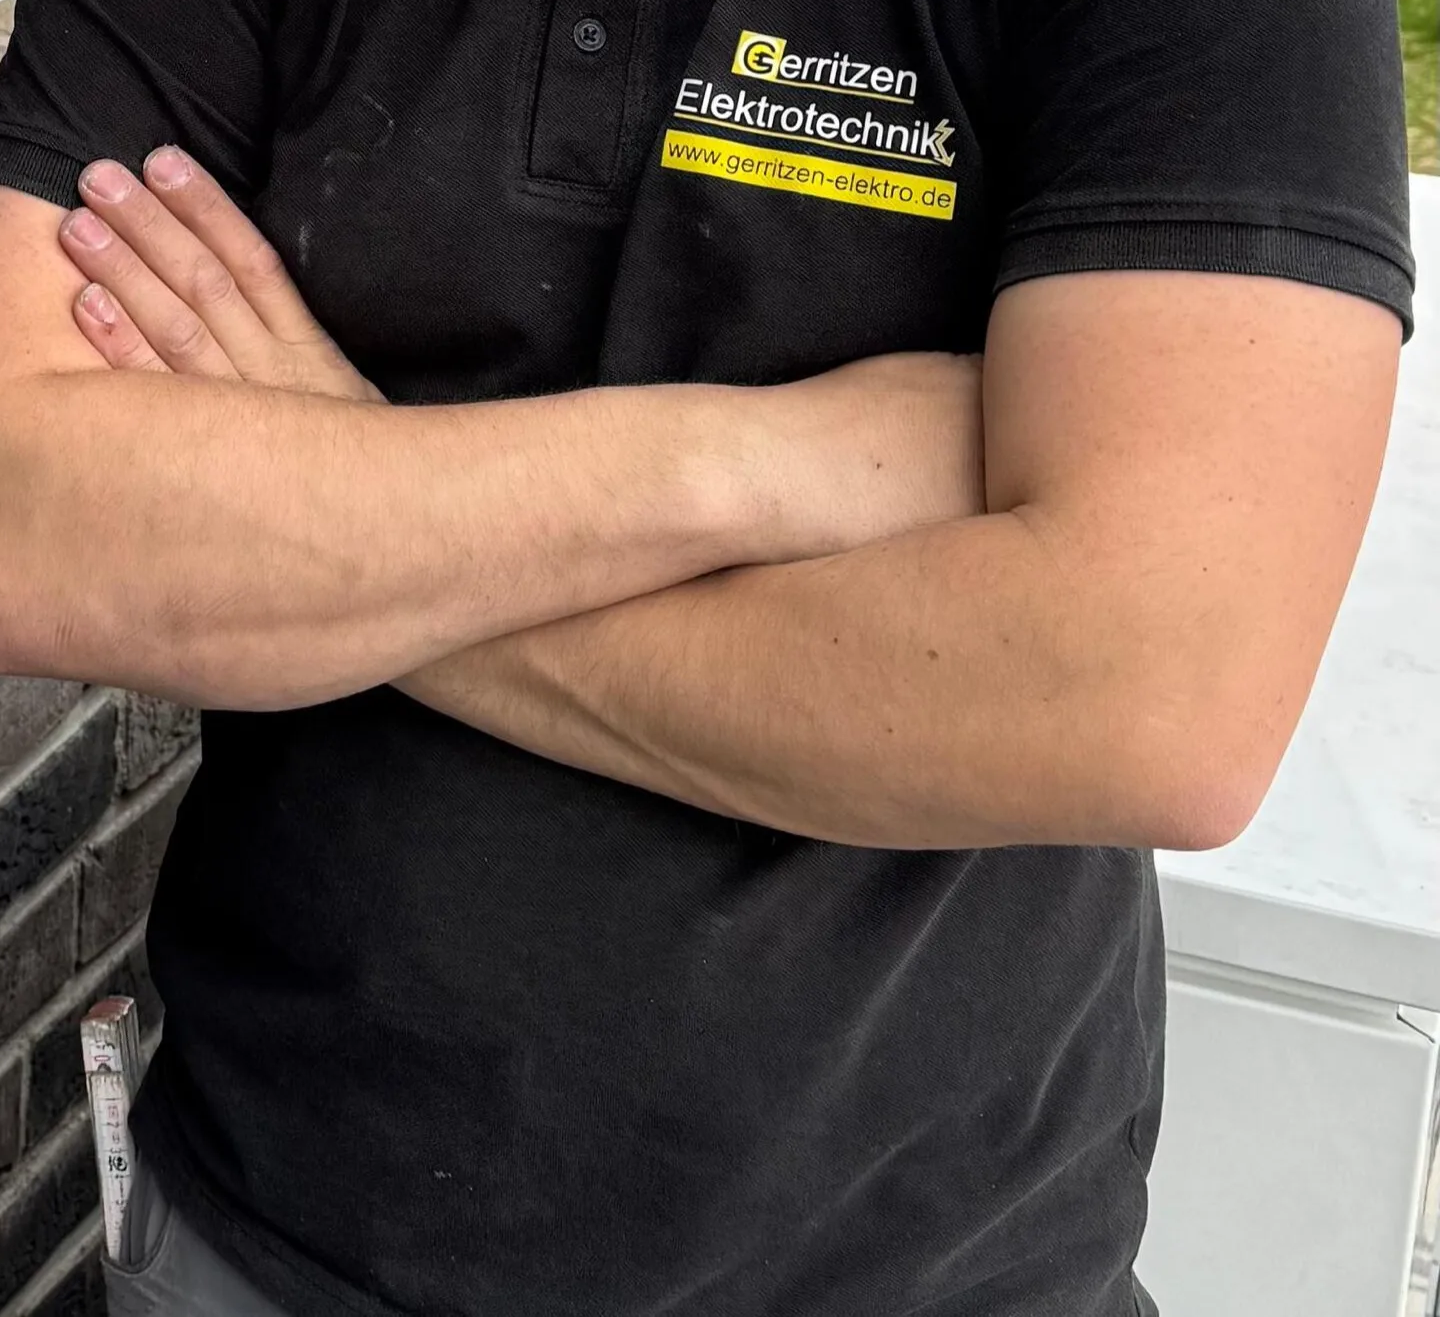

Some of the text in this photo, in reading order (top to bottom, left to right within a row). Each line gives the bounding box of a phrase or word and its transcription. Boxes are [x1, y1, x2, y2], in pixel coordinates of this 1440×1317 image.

[742, 40, 918, 97] Gerritzen
[674, 78, 943, 157] Elektrotechnik
[667, 140, 952, 209] www.gerritzen-elektro.de
